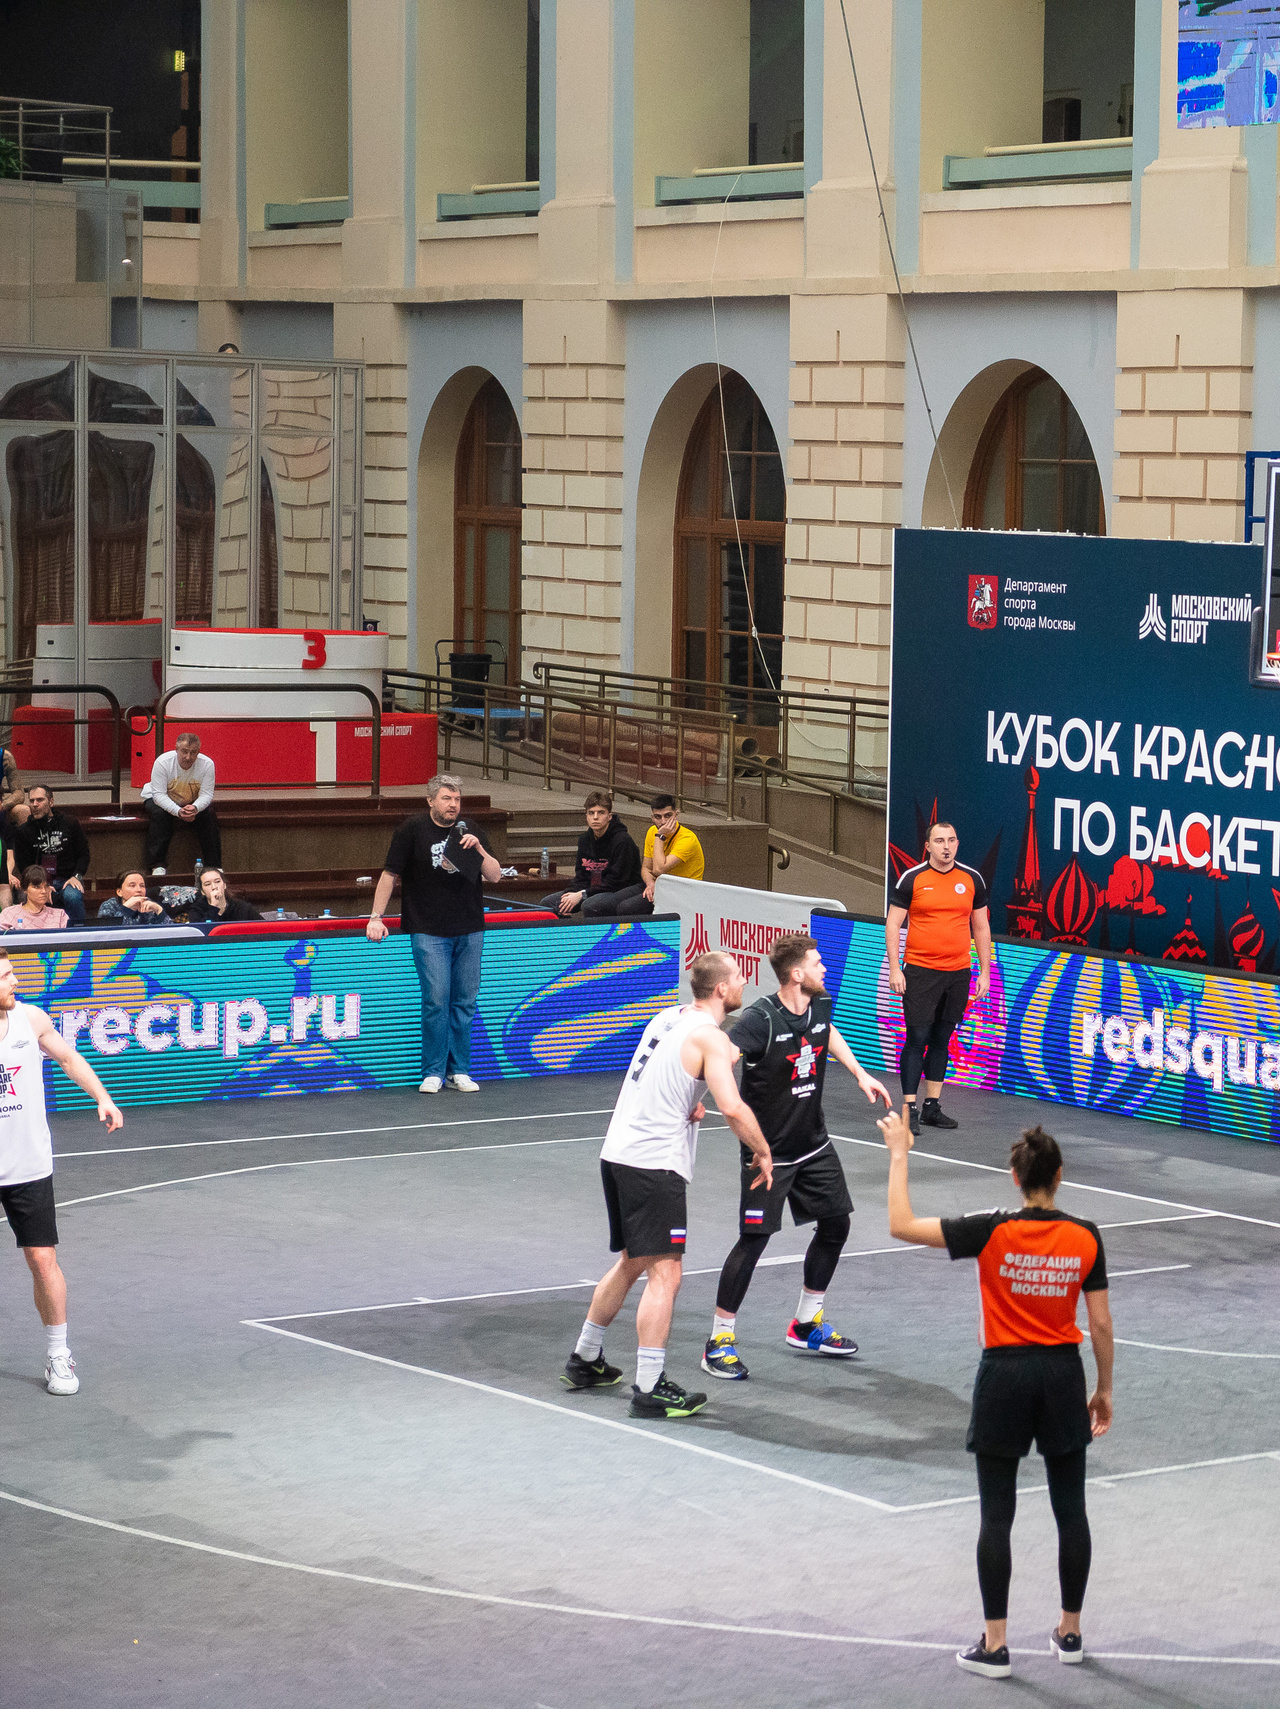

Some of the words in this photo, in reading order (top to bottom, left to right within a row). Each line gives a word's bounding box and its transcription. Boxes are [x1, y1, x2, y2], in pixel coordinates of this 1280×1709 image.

[1004, 577, 1067, 595] Департамент
[1004, 598, 1036, 613] спорта
[1171, 593, 1252, 622] МОСКОВСКИЙ
[1003, 616, 1036, 630] города
[1038, 615, 1076, 631] Москвы
[1170, 619, 1209, 645] СПОРТ
[302, 632, 326, 669] 3
[354, 723, 394, 737] МОСКСКИЙ
[310, 711, 336, 788] 1
[986, 710, 1121, 776] КУБОК
[1053, 797, 1116, 856] ПО
[720, 917, 808, 955] МОСКОВ
[1004, 1252, 1081, 1269] ФЕДЕРАЦИЯ
[999, 1264, 1080, 1284] БАСКЕТБОЛА
[1011, 1281, 1068, 1297] МОСКВЫ
